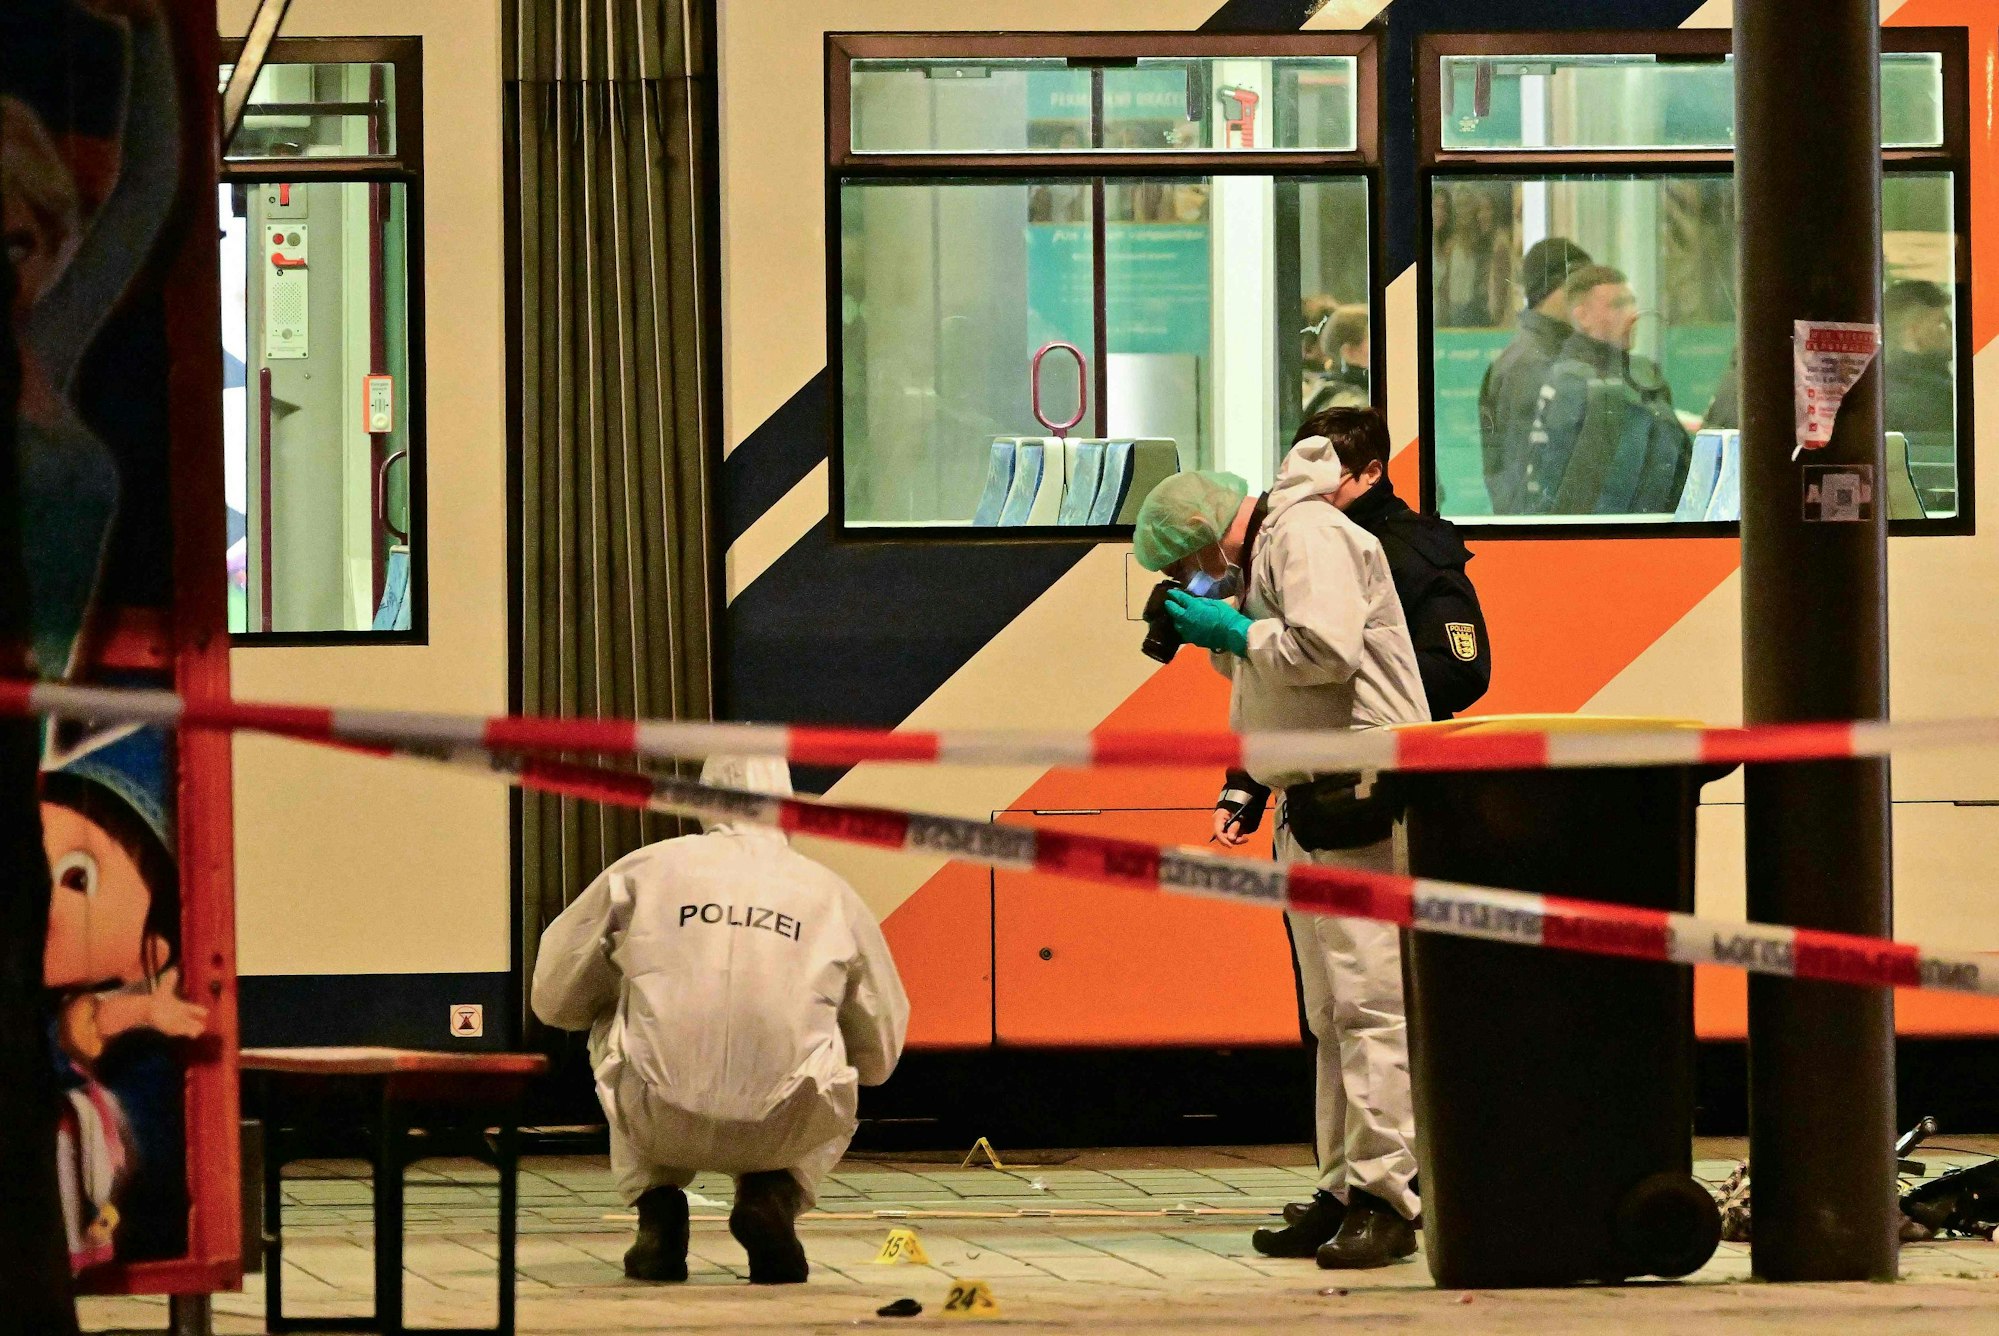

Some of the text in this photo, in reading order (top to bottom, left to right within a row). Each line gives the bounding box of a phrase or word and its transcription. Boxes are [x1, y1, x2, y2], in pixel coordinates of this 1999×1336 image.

[679, 903, 801, 942] POLIZEI
[882, 1236, 904, 1257] 15
[945, 1286, 977, 1310] 24
